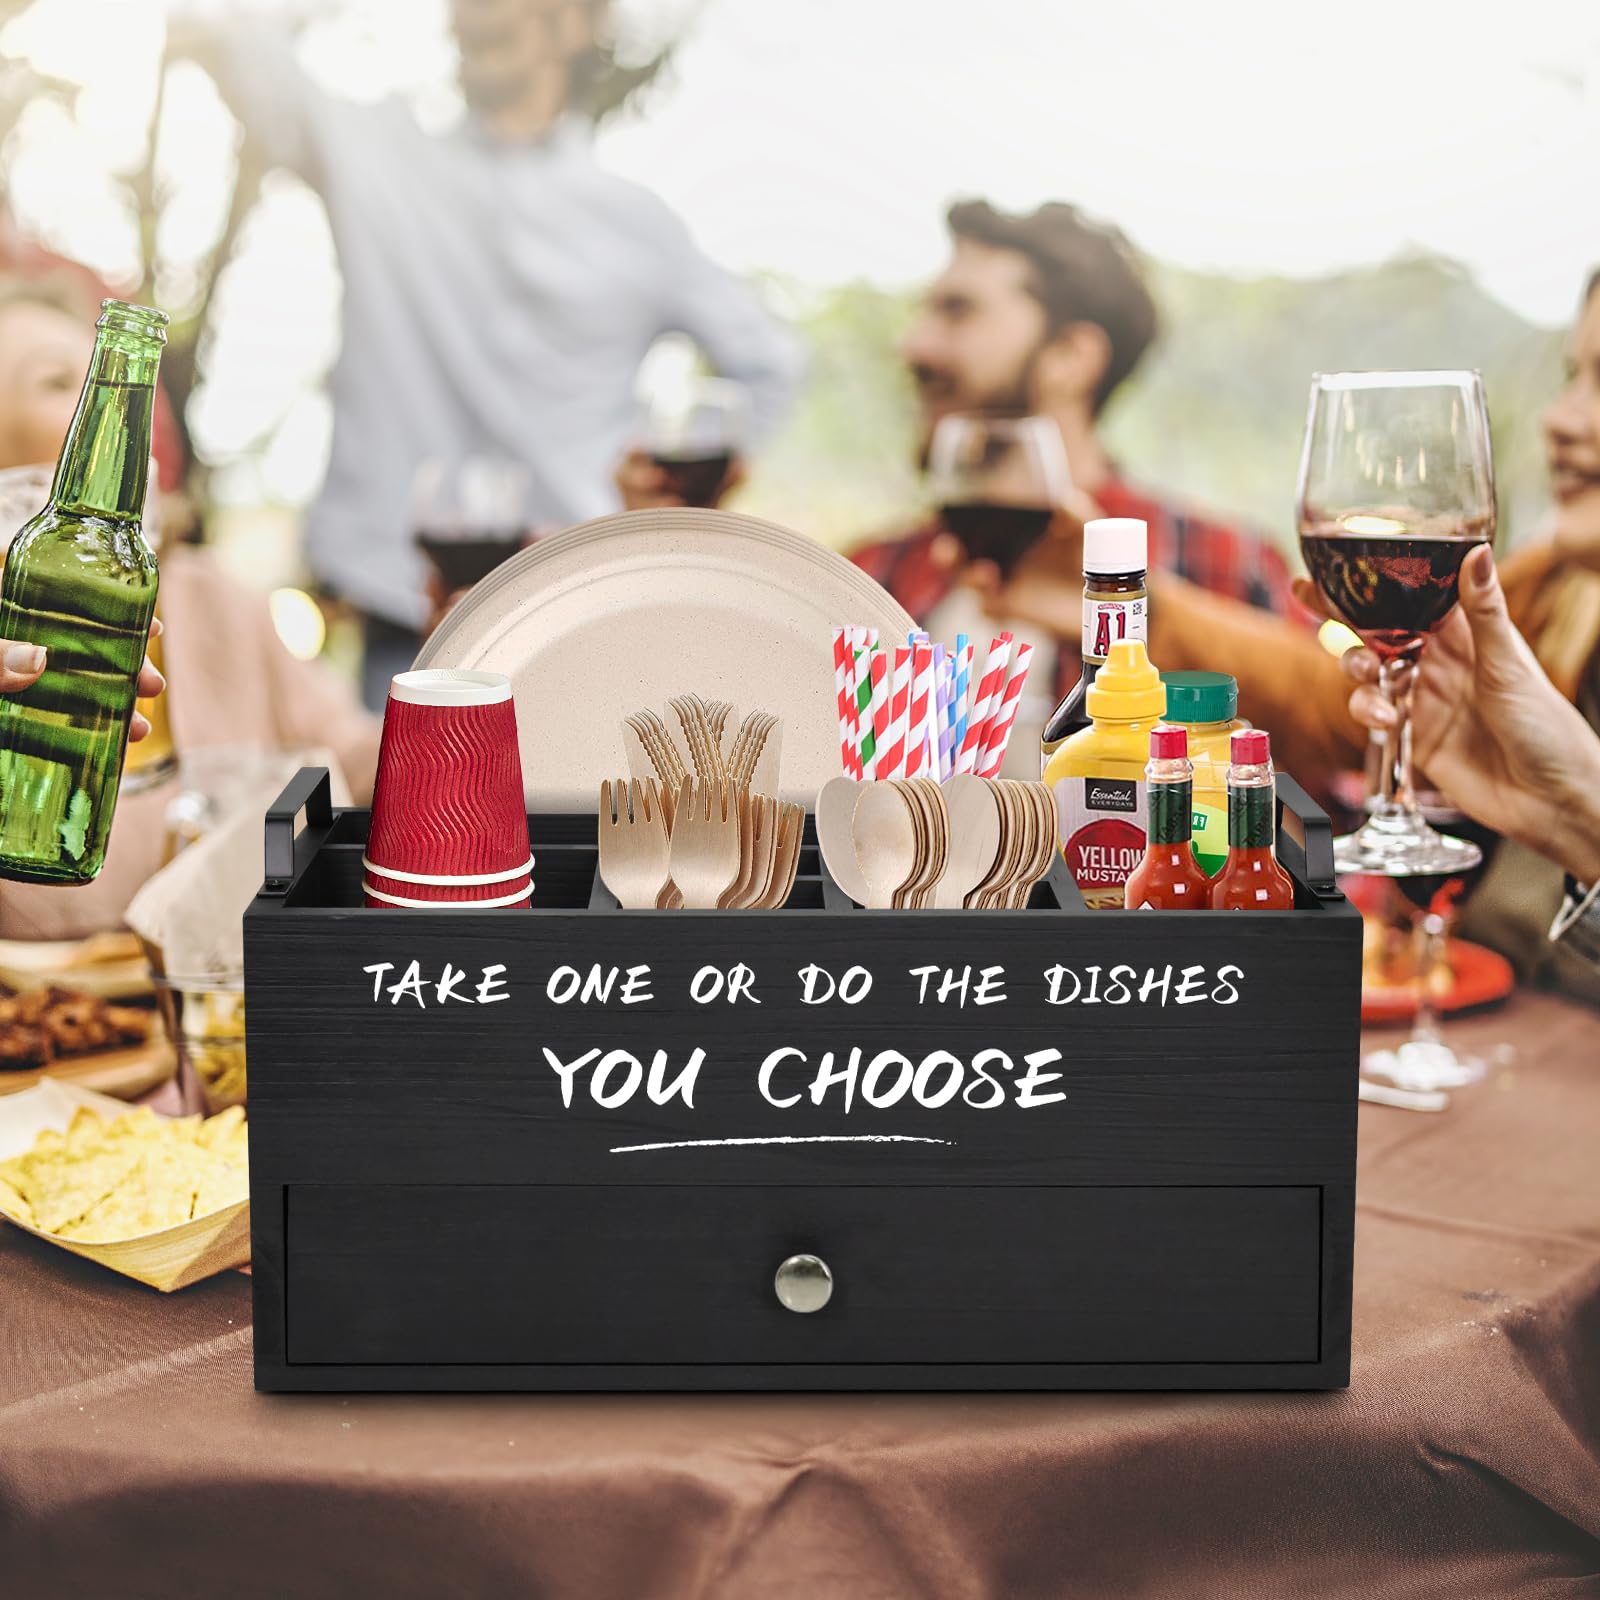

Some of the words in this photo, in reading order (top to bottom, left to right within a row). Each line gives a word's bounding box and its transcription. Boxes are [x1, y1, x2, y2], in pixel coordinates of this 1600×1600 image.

[1093, 611, 1126, 656] A1
[1090, 787, 1131, 801] Essential
[1078, 845, 1147, 870] YELLOW
[1076, 868, 1131, 883] MUSTA
[363, 960, 510, 1008] TAKE
[546, 963, 654, 1004] ONE
[690, 962, 761, 1004] OR
[798, 963, 872, 1004] DO
[909, 965, 1007, 1008] THE
[1044, 964, 1244, 1007] DISHES
[542, 1047, 706, 1109] YOU
[758, 1047, 1066, 1114] CHOOSE
